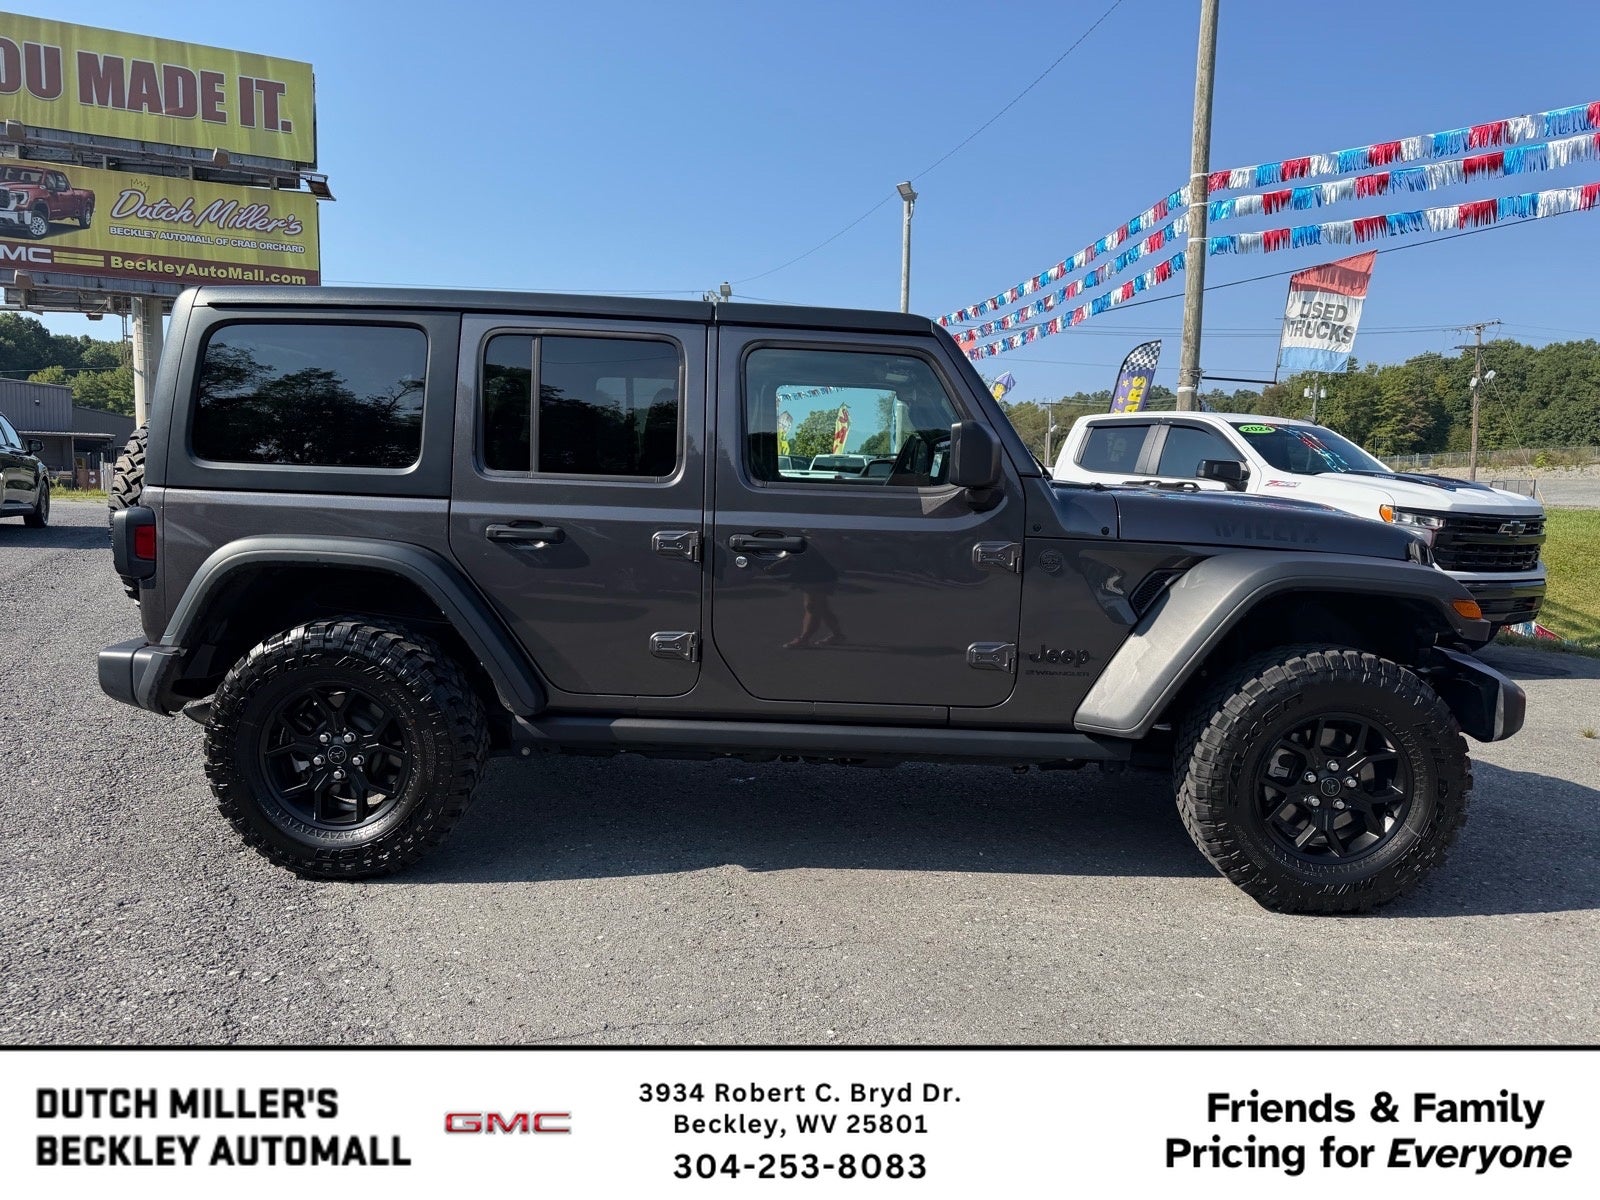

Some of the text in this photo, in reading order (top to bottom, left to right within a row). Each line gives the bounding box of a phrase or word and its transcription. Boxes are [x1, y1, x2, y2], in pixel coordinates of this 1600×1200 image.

[77, 50, 227, 124] MADE
[238, 75, 293, 133] IT.
[110, 188, 304, 236] Dutch Miller's
[109, 226, 305, 253] BECKLEY AUTOMALL OF CRAB ORCHARD
[110, 255, 307, 285] BeckleyAutoMall.com
[1300, 301, 1348, 322] USED
[1289, 320, 1355, 344] TRUCKS
[1029, 644, 1090, 668] Jeep
